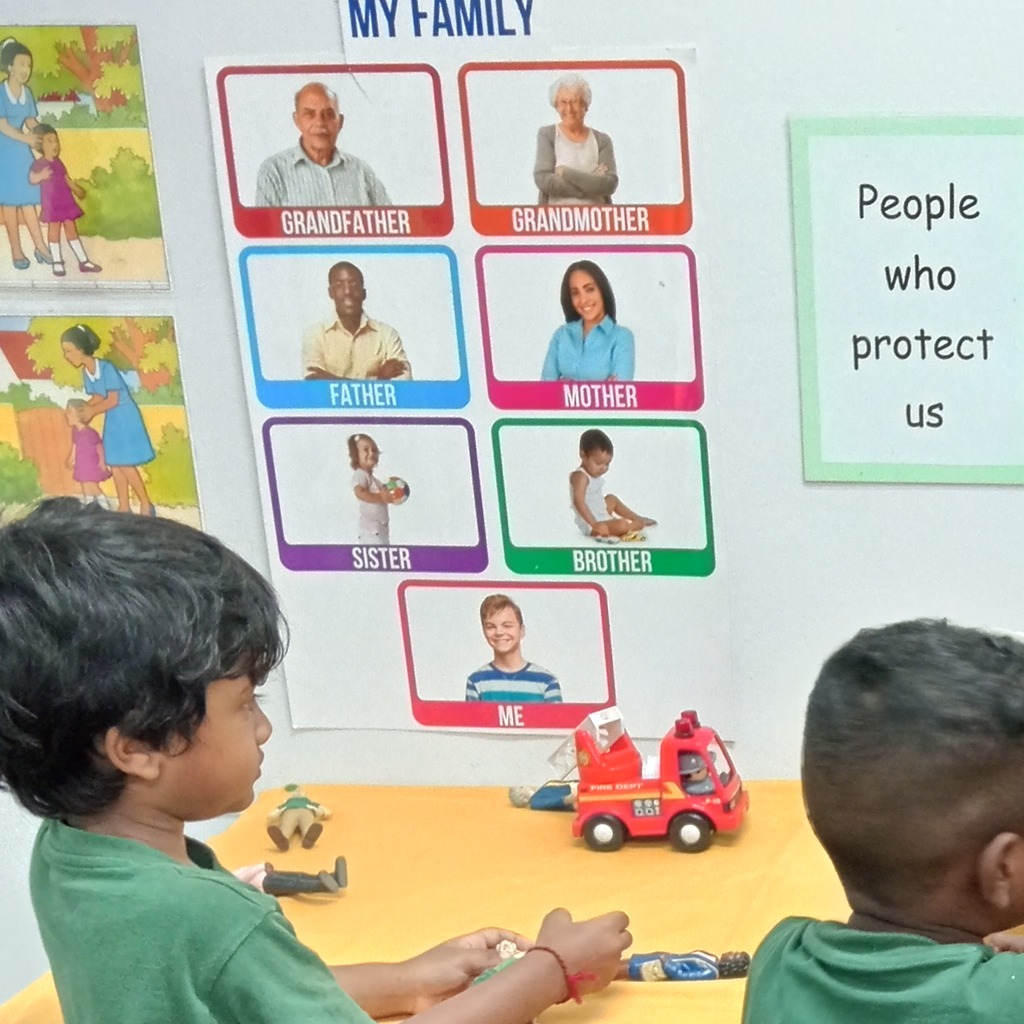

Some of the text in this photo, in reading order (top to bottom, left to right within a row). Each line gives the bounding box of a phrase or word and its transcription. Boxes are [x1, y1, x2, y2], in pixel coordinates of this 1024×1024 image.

[348, 0, 534, 38] MY FAMILY
[511, 206, 650, 233] GRANDMOTHER
[858, 182, 981, 231] People
[280, 208, 411, 236] GRANDFATHER
[884, 253, 957, 291] who
[852, 328, 994, 371] protect
[329, 383, 398, 407] FATHER
[562, 384, 638, 409] MOTHER
[905, 402, 944, 429] us
[351, 546, 412, 570] SISTER
[572, 549, 653, 574] BROTHER
[497, 705, 525, 728] ME
